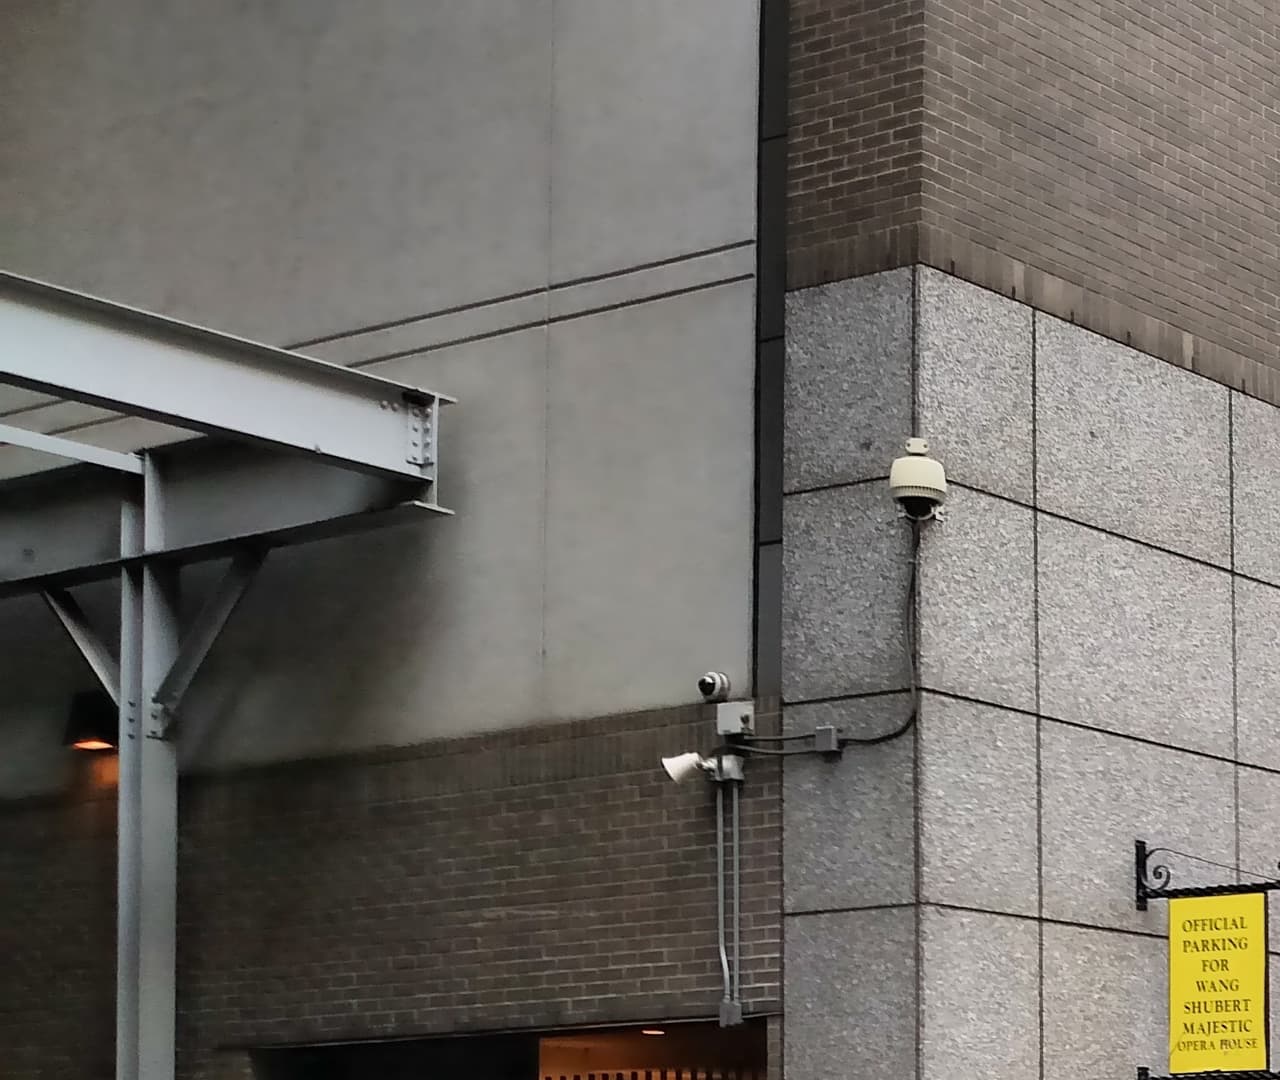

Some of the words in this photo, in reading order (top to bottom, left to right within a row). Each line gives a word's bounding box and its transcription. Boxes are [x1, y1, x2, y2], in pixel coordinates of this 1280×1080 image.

[1182, 917, 1248, 932] OFFICIAL
[1183, 937, 1248, 953] PARKING
[1202, 959, 1229, 972] FOR
[1196, 979, 1240, 993] WANG
[1184, 999, 1251, 1015] SHUBERT
[1183, 1020, 1253, 1036] MAJESTIC
[1177, 1039, 1216, 1051] OPERA
[1220, 1038, 1258, 1050] HOUSE
